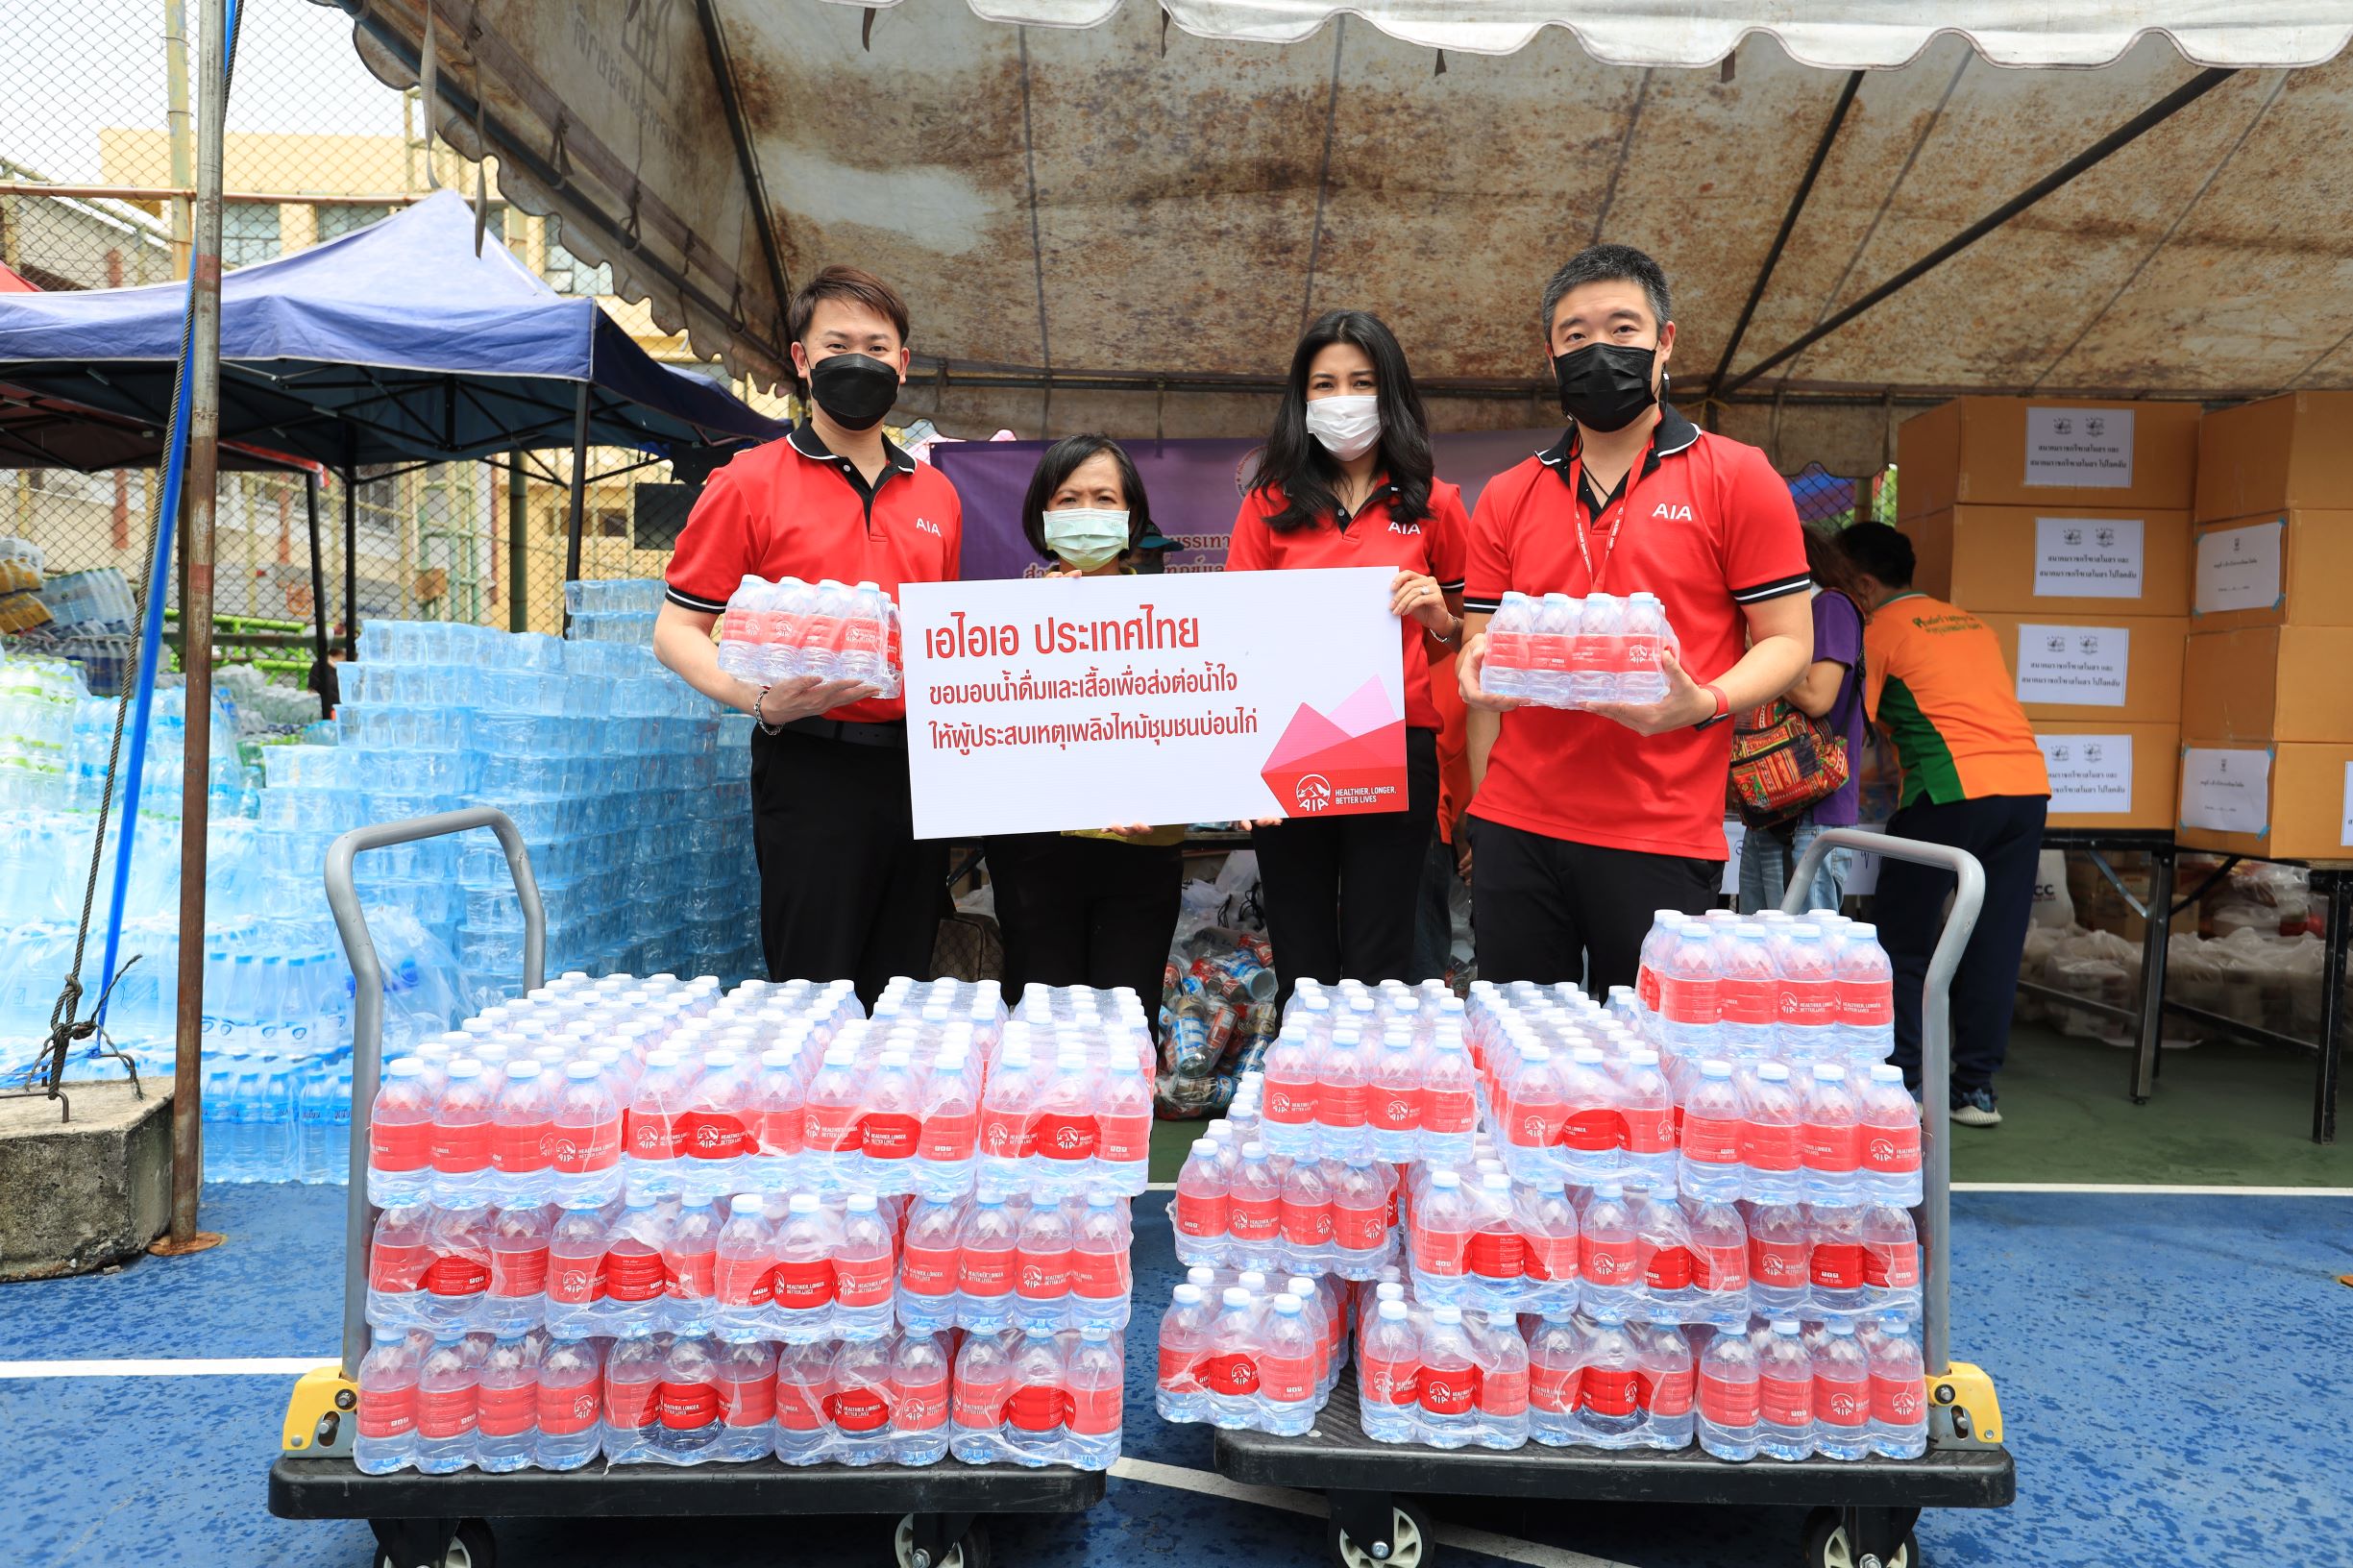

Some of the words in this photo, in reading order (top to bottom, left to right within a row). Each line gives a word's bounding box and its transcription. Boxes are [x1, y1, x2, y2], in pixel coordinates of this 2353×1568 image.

[1652, 502, 1693, 522] AIA
[916, 518, 942, 537] AIA
[1387, 521, 1421, 535] AIA
[925, 611, 1019, 659] เอไอเอ
[1034, 604, 1200, 654] ประเทศไทย
[928, 661, 1238, 705] ขอมอบน้ำดื่มและเสื้อเพื่อส่งต่อน้ำใจ
[928, 706, 1259, 756] ให้ผู้ประสบเหตุเพลิงไหม้ชุมชนบ่อนไก่
[1299, 798, 1329, 812] AIA
[1336, 796, 1359, 805] BETTER
[1360, 795, 1377, 803] LIVES
[1431, 1395, 1449, 1404] AIA
[906, 1411, 923, 1420] AIA
[1832, 1407, 1852, 1415] AIA
